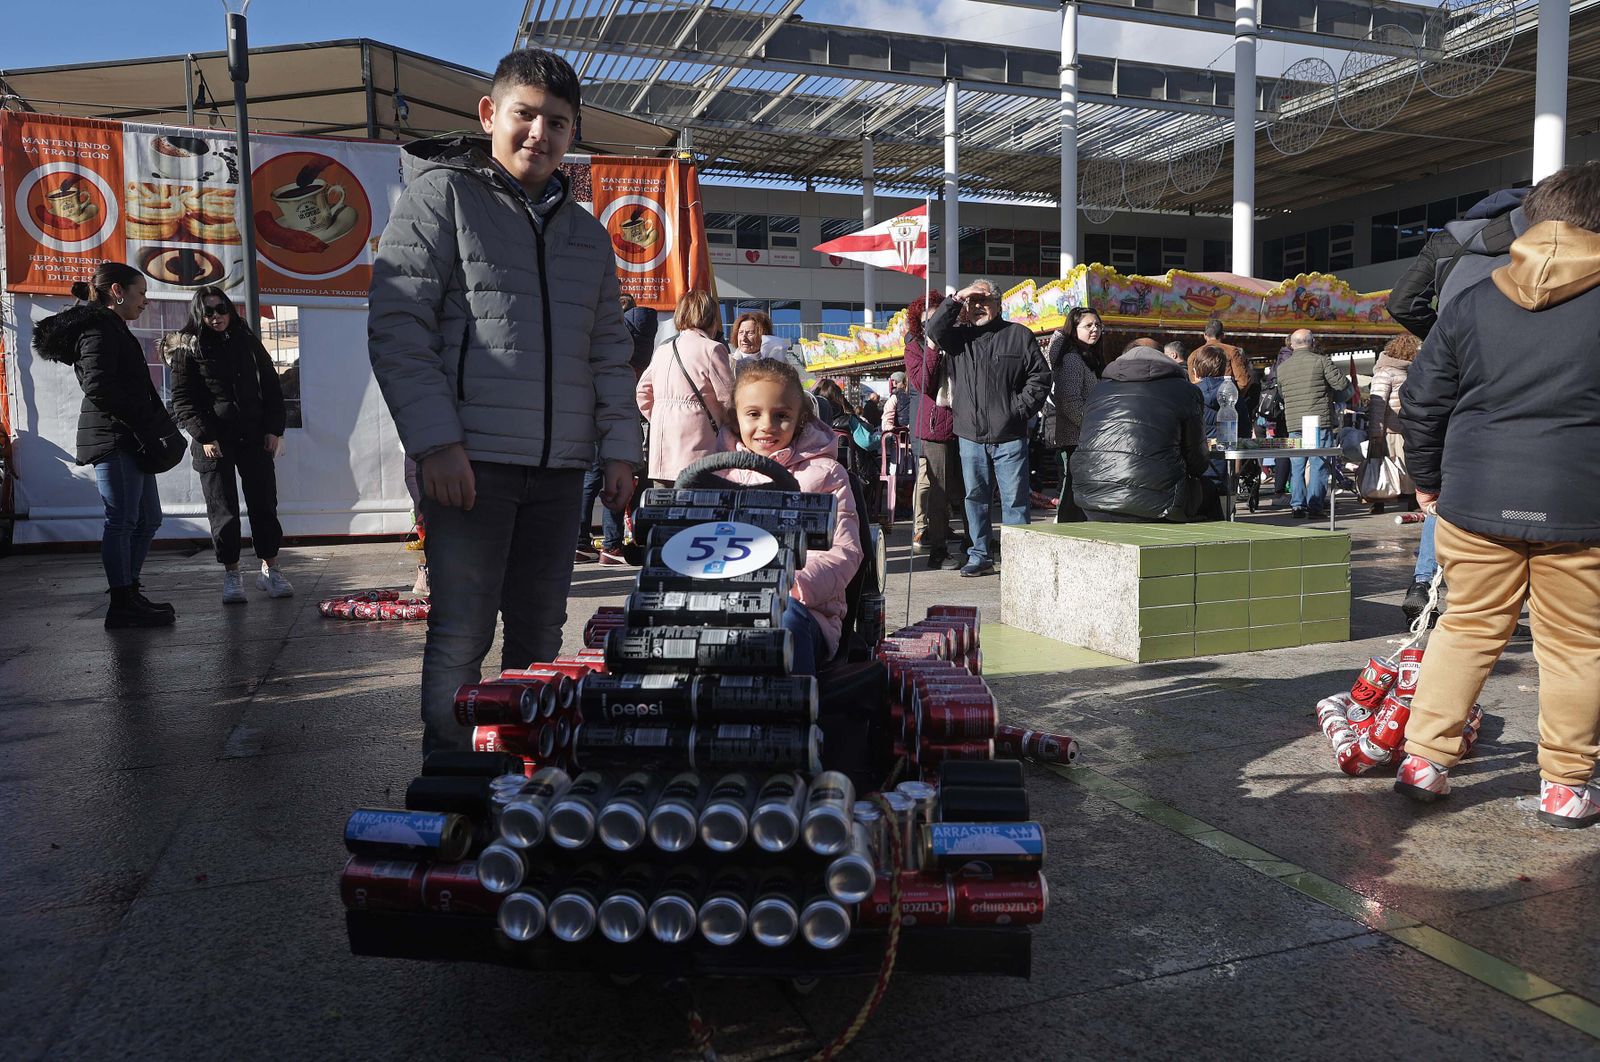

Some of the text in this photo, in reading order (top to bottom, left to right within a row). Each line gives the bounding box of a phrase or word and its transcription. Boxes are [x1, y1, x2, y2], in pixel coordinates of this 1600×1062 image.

[22, 136, 110, 150] MANTENIENDO
[42, 147, 109, 159] TRADICIÓN
[600, 177, 665, 185] MANTENIENDO
[616, 184, 665, 193] TRADICIÓN
[28, 254, 112, 265] REPARTIENDO
[34, 264, 96, 273] MOMENTO
[260, 287, 317, 295] MANTENIENDO
[686, 536, 754, 562] 55
[611, 701, 664, 718] pepsi
[349, 812, 411, 825] ARRASTRE
[932, 826, 1000, 838] ARRASTRE
[876, 902, 942, 915] Cruzcapo
[971, 901, 1038, 914] Cruzcampo
